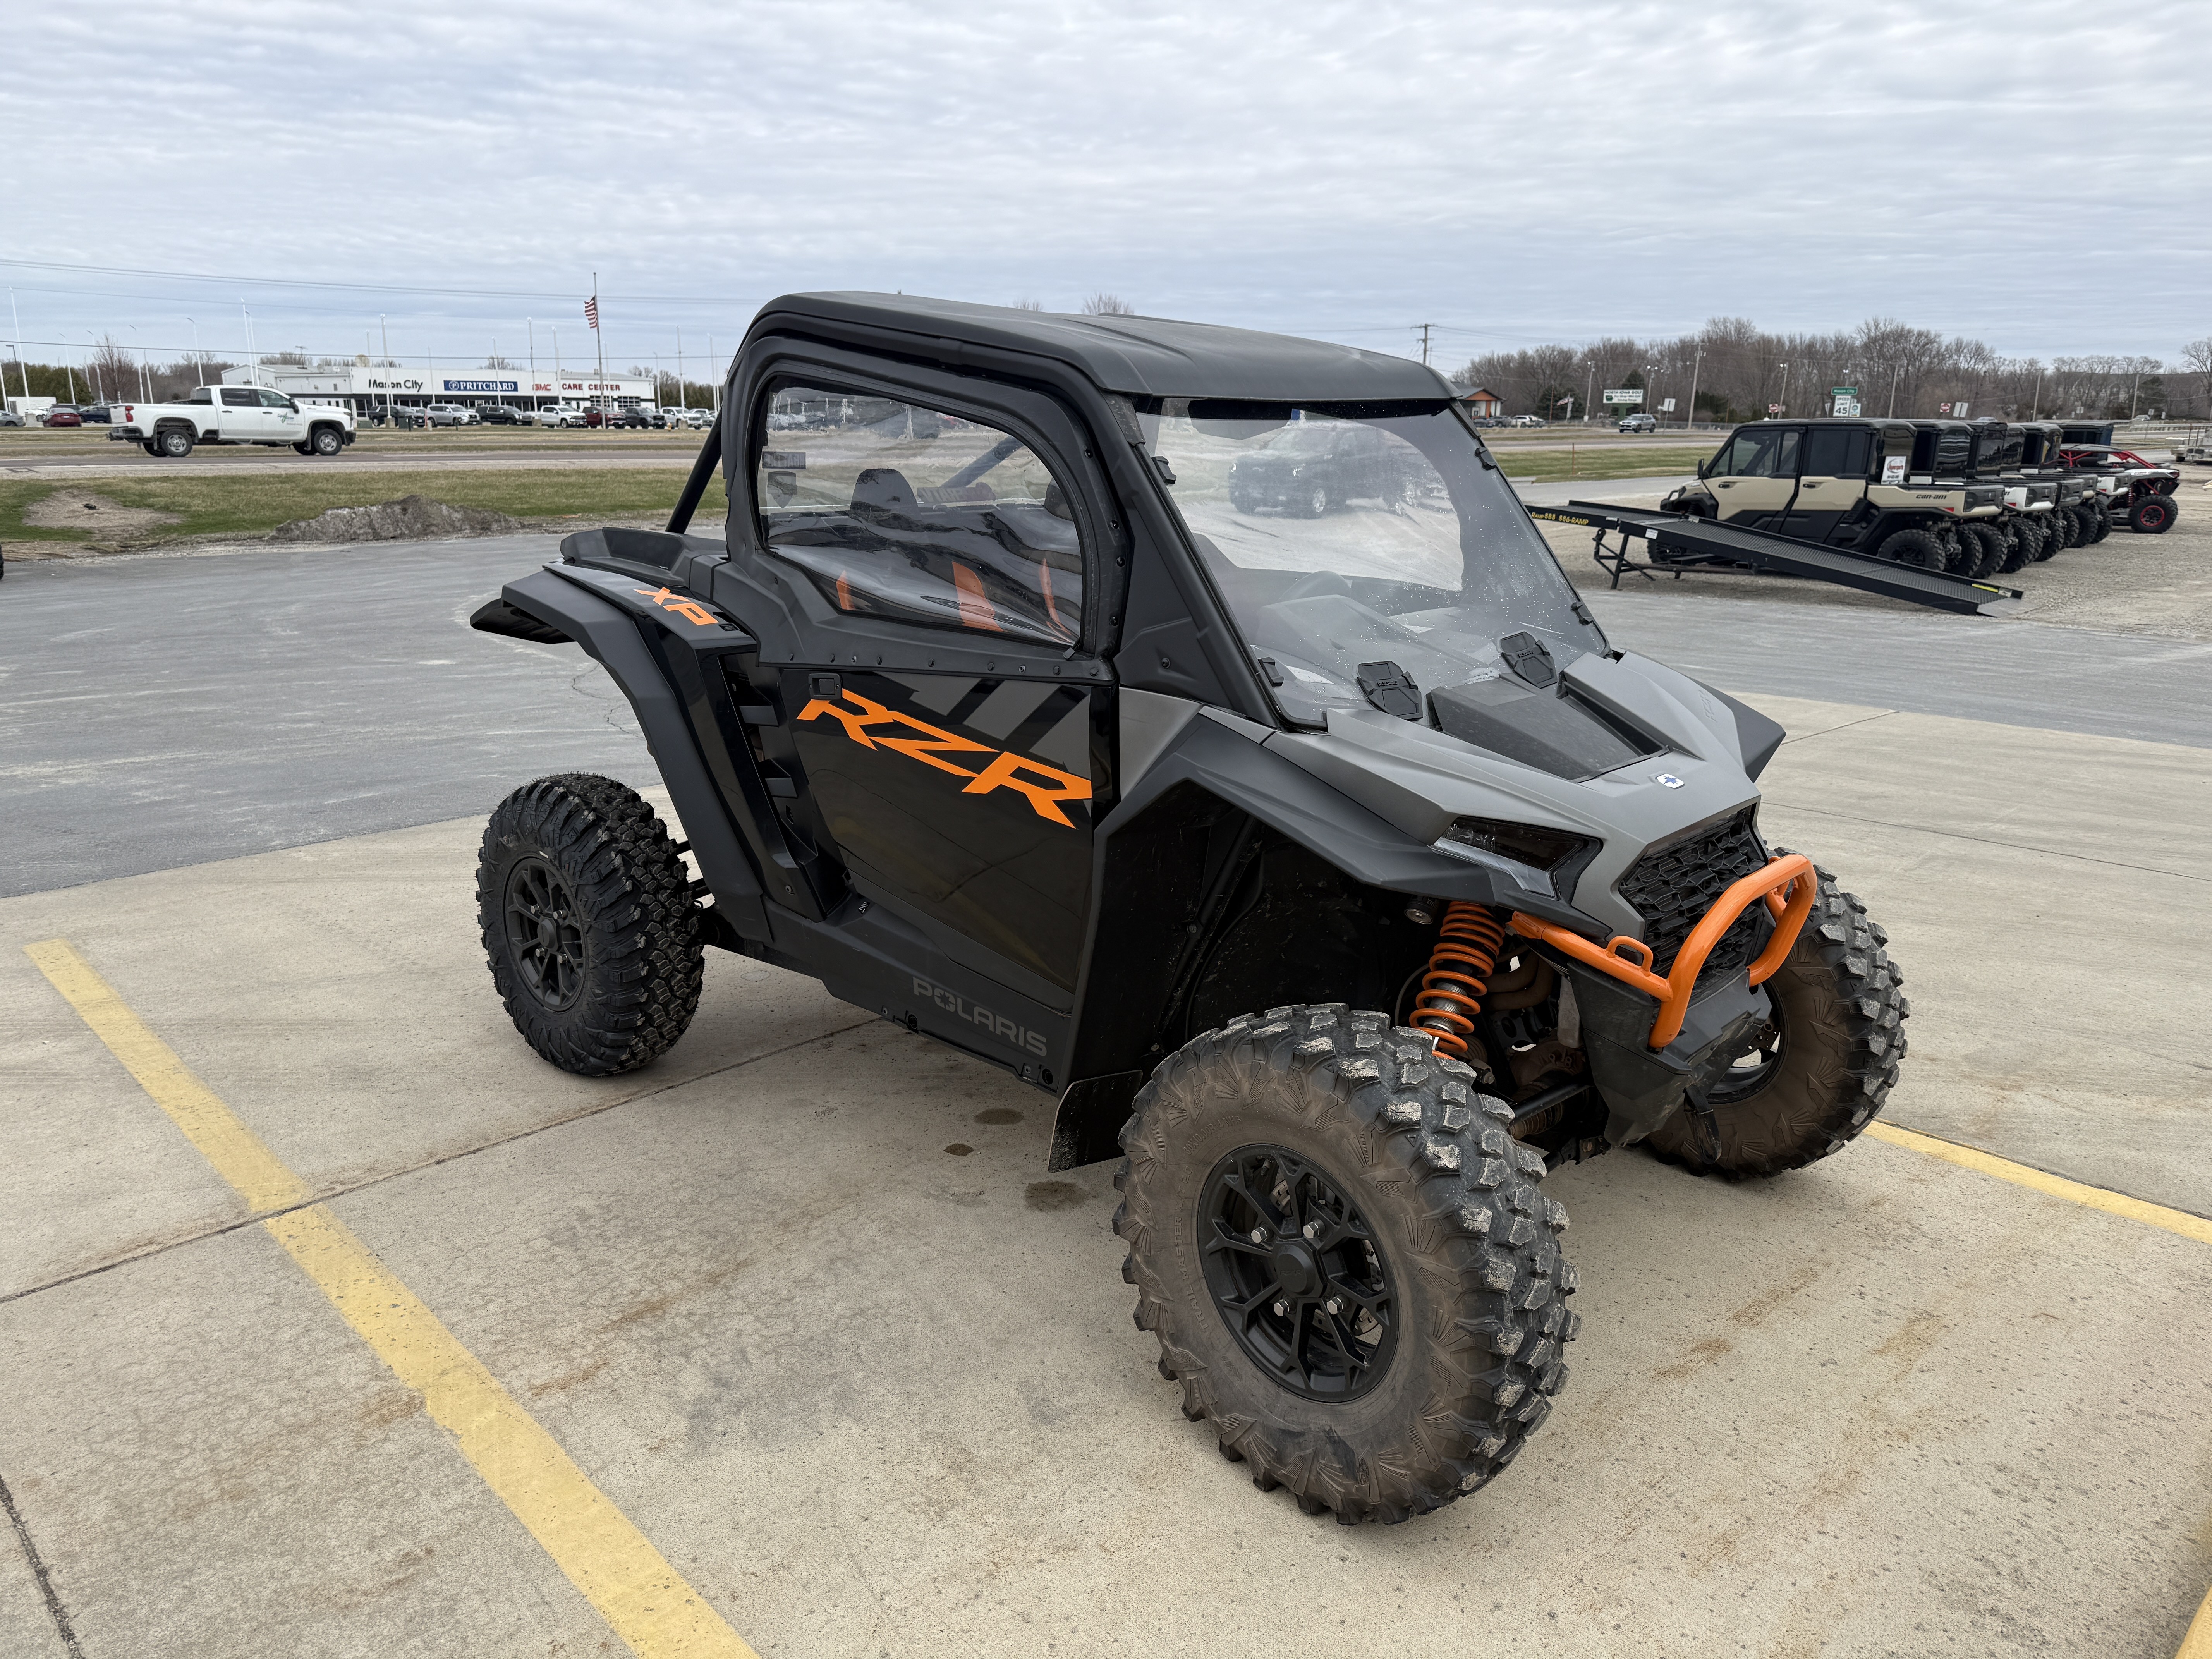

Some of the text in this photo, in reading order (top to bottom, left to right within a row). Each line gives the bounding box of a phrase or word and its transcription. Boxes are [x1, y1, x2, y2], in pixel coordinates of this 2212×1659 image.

[404, 379, 423, 392] City
[460, 381, 515, 390] PRITCHARD
[634, 587, 719, 625] XP
[797, 688, 1092, 829] RZR
[913, 977, 1047, 1057] POLARIS
[1174, 1216, 1190, 1280] MASTER
[1187, 1284, 1209, 1329] TRAIL
